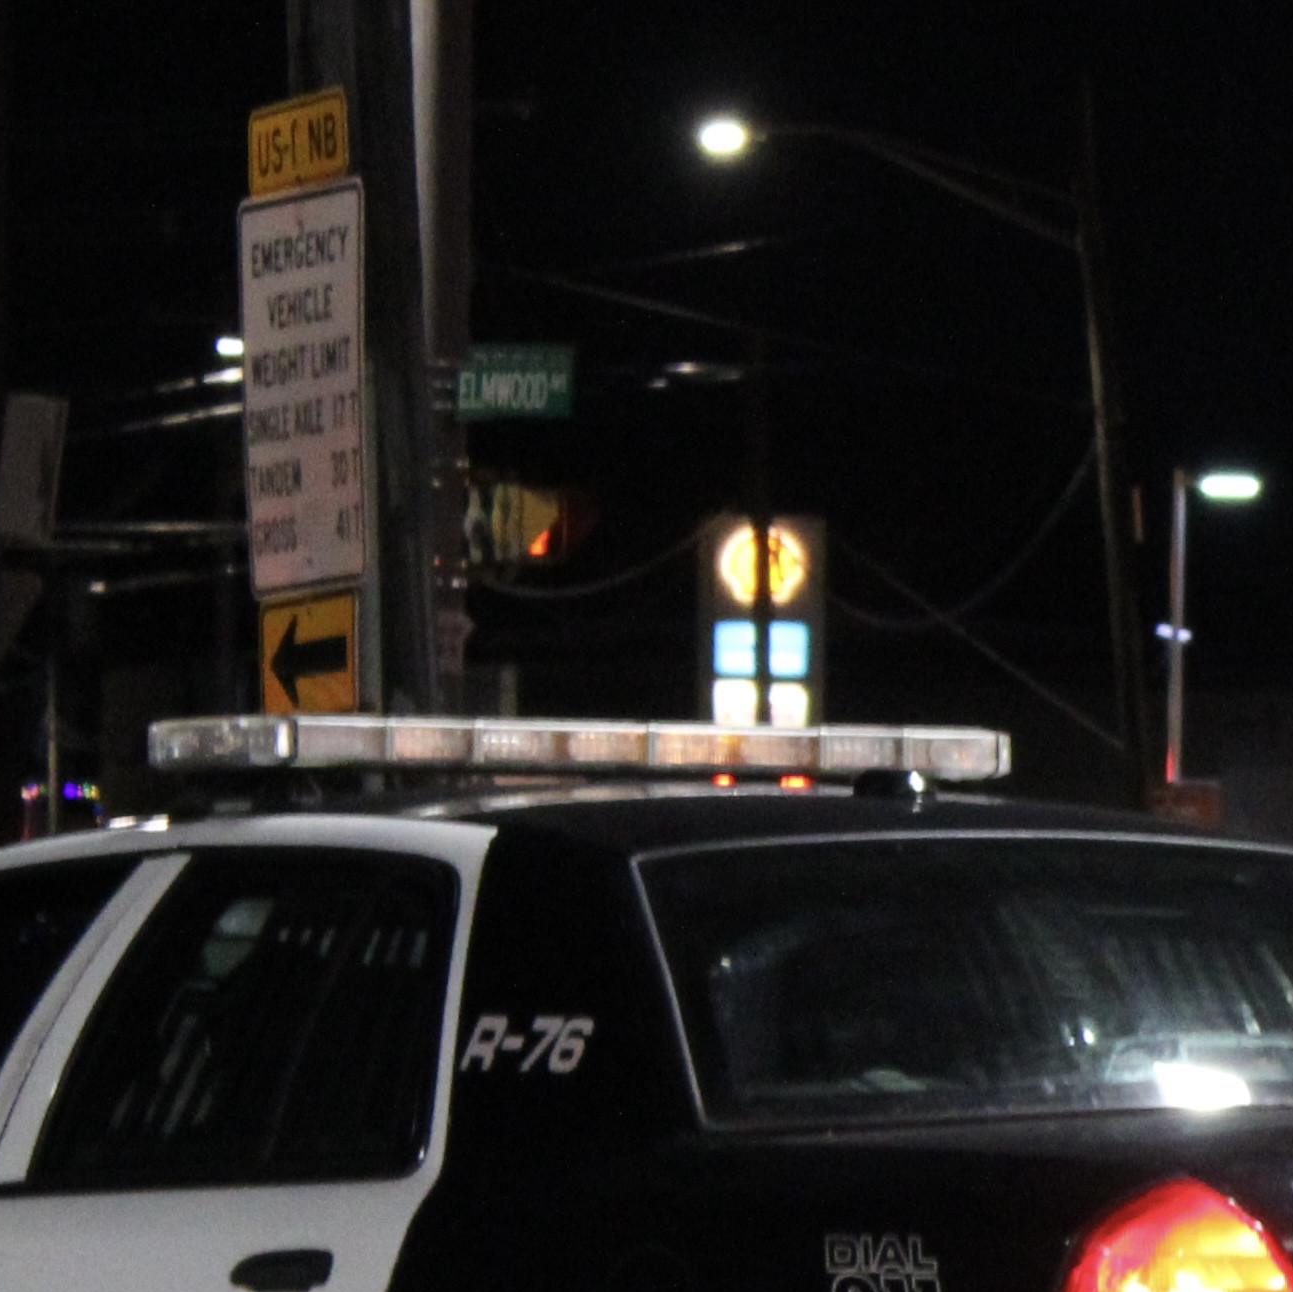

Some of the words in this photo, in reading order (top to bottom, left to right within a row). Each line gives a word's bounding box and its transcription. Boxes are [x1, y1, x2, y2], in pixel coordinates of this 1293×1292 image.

[307, 111, 338, 165] NB
[251, 224, 349, 280] EMERGENCY
[266, 282, 333, 331] VEHICLE
[251, 343, 306, 390] WEIGHT
[310, 335, 351, 380] LIMIT
[458, 369, 548, 411] ELMWOOD
[460, 1013, 596, 1074] R-76
[824, 1235, 939, 1276] DIAL
